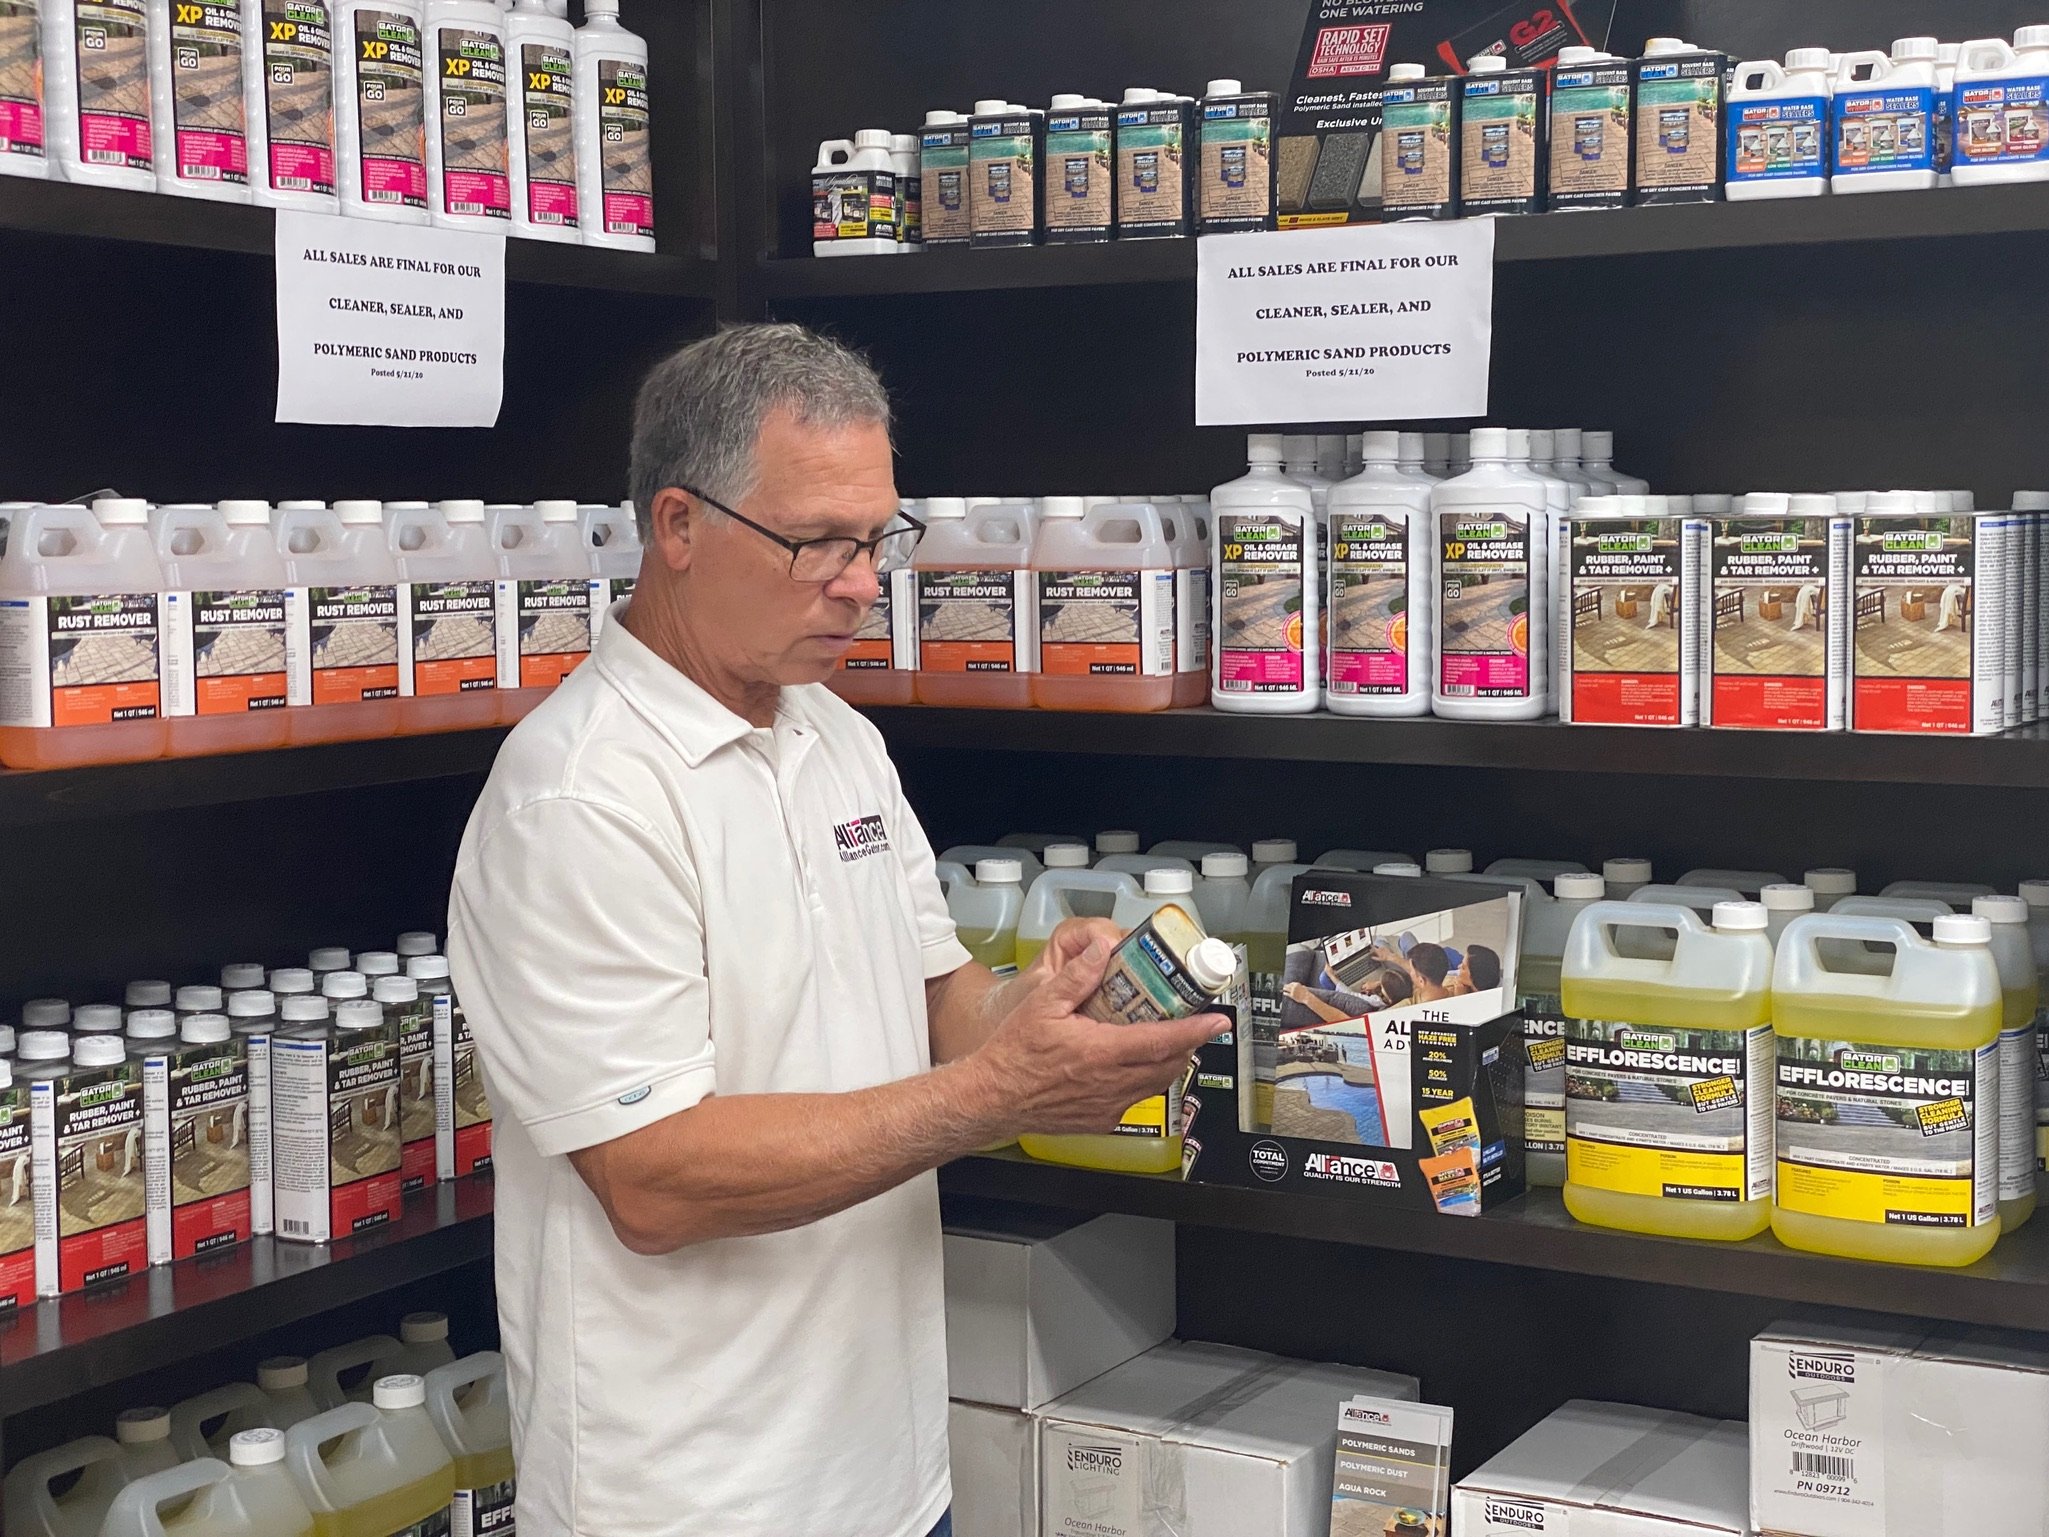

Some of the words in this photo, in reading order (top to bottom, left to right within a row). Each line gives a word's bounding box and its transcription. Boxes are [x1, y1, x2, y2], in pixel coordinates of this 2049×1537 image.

[177, 4, 202, 23] XP
[1320, 8, 1347, 19] ONE
[1352, 2, 1423, 16] WATERING
[270, 22, 296, 40] XP
[1509, 10, 1557, 45] G2
[1322, 30, 1360, 45] RAPID
[1362, 28, 1385, 42] SET
[363, 41, 388, 59] XP
[1321, 42, 1381, 56] TECHNOLOGY
[390, 52, 421, 67] REMOVER
[446, 58, 470, 76] XP
[1311, 66, 1334, 74] OSHA
[529, 73, 550, 89] XP
[604, 88, 625, 104] XP
[1296, 94, 1345, 104] Cleanest,
[1349, 92, 1382, 100] Fastes
[2007, 91, 2041, 100] SEALERS
[1294, 104, 1329, 112] Polymeric
[1886, 102, 1919, 110] SEALERS
[1317, 118, 1367, 128] Exclusive
[304, 249, 327, 261] ALL
[330, 251, 366, 266] SALES
[370, 256, 394, 268] ARE
[397, 259, 431, 273] FINAL
[433, 263, 455, 275] FOR
[458, 266, 481, 277] OUR
[1228, 267, 1255, 278] ALL
[1258, 264, 1302, 277] SALES
[1306, 262, 1336, 274] ARE
[1340, 259, 1386, 272] FINAL
[1390, 257, 1420, 269] FOR
[1425, 255, 1458, 267] OUR
[329, 298, 388, 316] CLEANER,
[390, 304, 436, 320] SEALER,
[439, 308, 463, 319] AND
[1256, 306, 1327, 319] CLEANER,
[1331, 303, 1393, 316] SEALER,
[1397, 301, 1431, 312] AND
[314, 343, 382, 358] POLYMERIC
[385, 348, 416, 361] SAND
[420, 351, 477, 364] PRODUCTS
[1237, 350, 1320, 363] POLYMERIC
[1323, 347, 1365, 359] SAND
[1369, 343, 1451, 357] PRODUCTS
[371, 369, 394, 378] Posted
[397, 370, 423, 379] 5/21/20
[1306, 369, 1336, 377] Posted
[1339, 368, 1375, 376] 5/21/20
[1457, 530, 1490, 538] CLEAN
[1224, 544, 1242, 560] XP
[1244, 551, 1297, 560] REMOVER
[1445, 543, 1465, 559] XP
[1467, 550, 1523, 559] REMOVER
[1586, 555, 1631, 566] RUBBER,
[1634, 555, 1665, 564] PAINT
[1727, 555, 1775, 566] RUBBER,
[1778, 555, 1812, 564] PAINT
[1869, 555, 1918, 565] RUBBER,
[1921, 554, 1957, 563] PAINT
[1589, 565, 1610, 575] TAR
[1612, 565, 1663, 575] REMOVER
[1730, 566, 1752, 575] TAR
[1755, 565, 1809, 575] REMOVER
[1862, 565, 1869, 574] &
[1872, 565, 1895, 574] TAR
[1897, 565, 1956, 574] REMOVER
[924, 586, 950, 597] RUST
[953, 586, 1006, 596] REMOVER
[1046, 587, 1074, 597] RUST
[1077, 586, 1132, 597] REMOVER
[420, 600, 445, 611] RUST
[447, 598, 490, 610] REMOVER
[525, 597, 547, 607] RUST
[549, 596, 586, 607] REMOVER
[58, 616, 91, 629] RUST
[94, 613, 151, 627] REMOVER
[201, 609, 231, 622] RUST
[232, 608, 282, 621] REMOVER
[833, 815, 887, 850] Alliance
[1303, 890, 1339, 901] Alliance
[1423, 1010, 1450, 1022] THE
[1438, 1035, 1456, 1043] FREE
[1623, 1033, 1658, 1042] GATOR
[1623, 1040, 1659, 1049] CLEAN
[1567, 1045, 1737, 1074] EFFLORESCENCE
[1843, 1053, 1882, 1063] GATOR
[339, 1065, 371, 1080] RUBBER,
[373, 1058, 394, 1072] PAINT
[1843, 1060, 1882, 1071] CLEAN
[182, 1082, 217, 1096] RUBBER,
[219, 1074, 242, 1088] PAINT
[342, 1078, 357, 1088] TAR
[358, 1070, 392, 1085] REMOVER
[1779, 1065, 1966, 1096] EFFLORESCENCE
[184, 1096, 201, 1107] TAR
[203, 1086, 241, 1103] REMOVER
[1422, 1088, 1431, 1096] 15
[1432, 1088, 1454, 1097] YEAR
[70, 1107, 108, 1122] RUBBER,
[110, 1099, 135, 1113] PAINT
[1918, 1099, 1960, 1112] STRONGER
[1920, 1106, 1962, 1118] CLEANING
[73, 1121, 91, 1132] TAR
[92, 1111, 134, 1128] REMOVER
[1921, 1112, 1963, 1125] FORMULA
[1939, 1117, 1965, 1127] GENTLE
[1946, 1122, 1967, 1132] PAVERS
[1253, 1150, 1285, 1161] TOTAL
[1849, 1156, 1890, 1164] CONCENTRATED
[1305, 1153, 1376, 1177] Alliance
[1304, 1171, 1335, 1180] QUALITY
[1345, 1175, 1361, 1183] OUR
[1362, 1178, 1401, 1188] STRENGTH
[1907, 1214, 1917, 1222] US
[1918, 1214, 1939, 1223] Gallon
[1943, 1215, 1957, 1223] 3.78
[1797, 1359, 1854, 1375] ENDURO
[1805, 1372, 1845, 1381] OUTDOORS
[1784, 1429, 1818, 1442] Ocean
[1822, 1434, 1862, 1447] Harbor
[1342, 1439, 1387, 1452] POLYMERIC
[1389, 1446, 1416, 1457] SANDS
[1791, 1441, 1824, 1450] Driftwood
[1075, 1451, 1121, 1468] ENDURO
[1075, 1461, 1119, 1476] LIGHTING
[1340, 1461, 1385, 1474] POLYMERIC
[1387, 1467, 1408, 1479] DUST
[1339, 1483, 1361, 1494] AQUA
[1364, 1486, 1387, 1497] ROCK
[1797, 1481, 1813, 1490] PN
[1816, 1483, 1850, 1496] 09712
[1492, 1504, 1544, 1523] ENDURO
[1065, 1517, 1092, 1530] Ocean
[1095, 1523, 1126, 1536] Harbor
